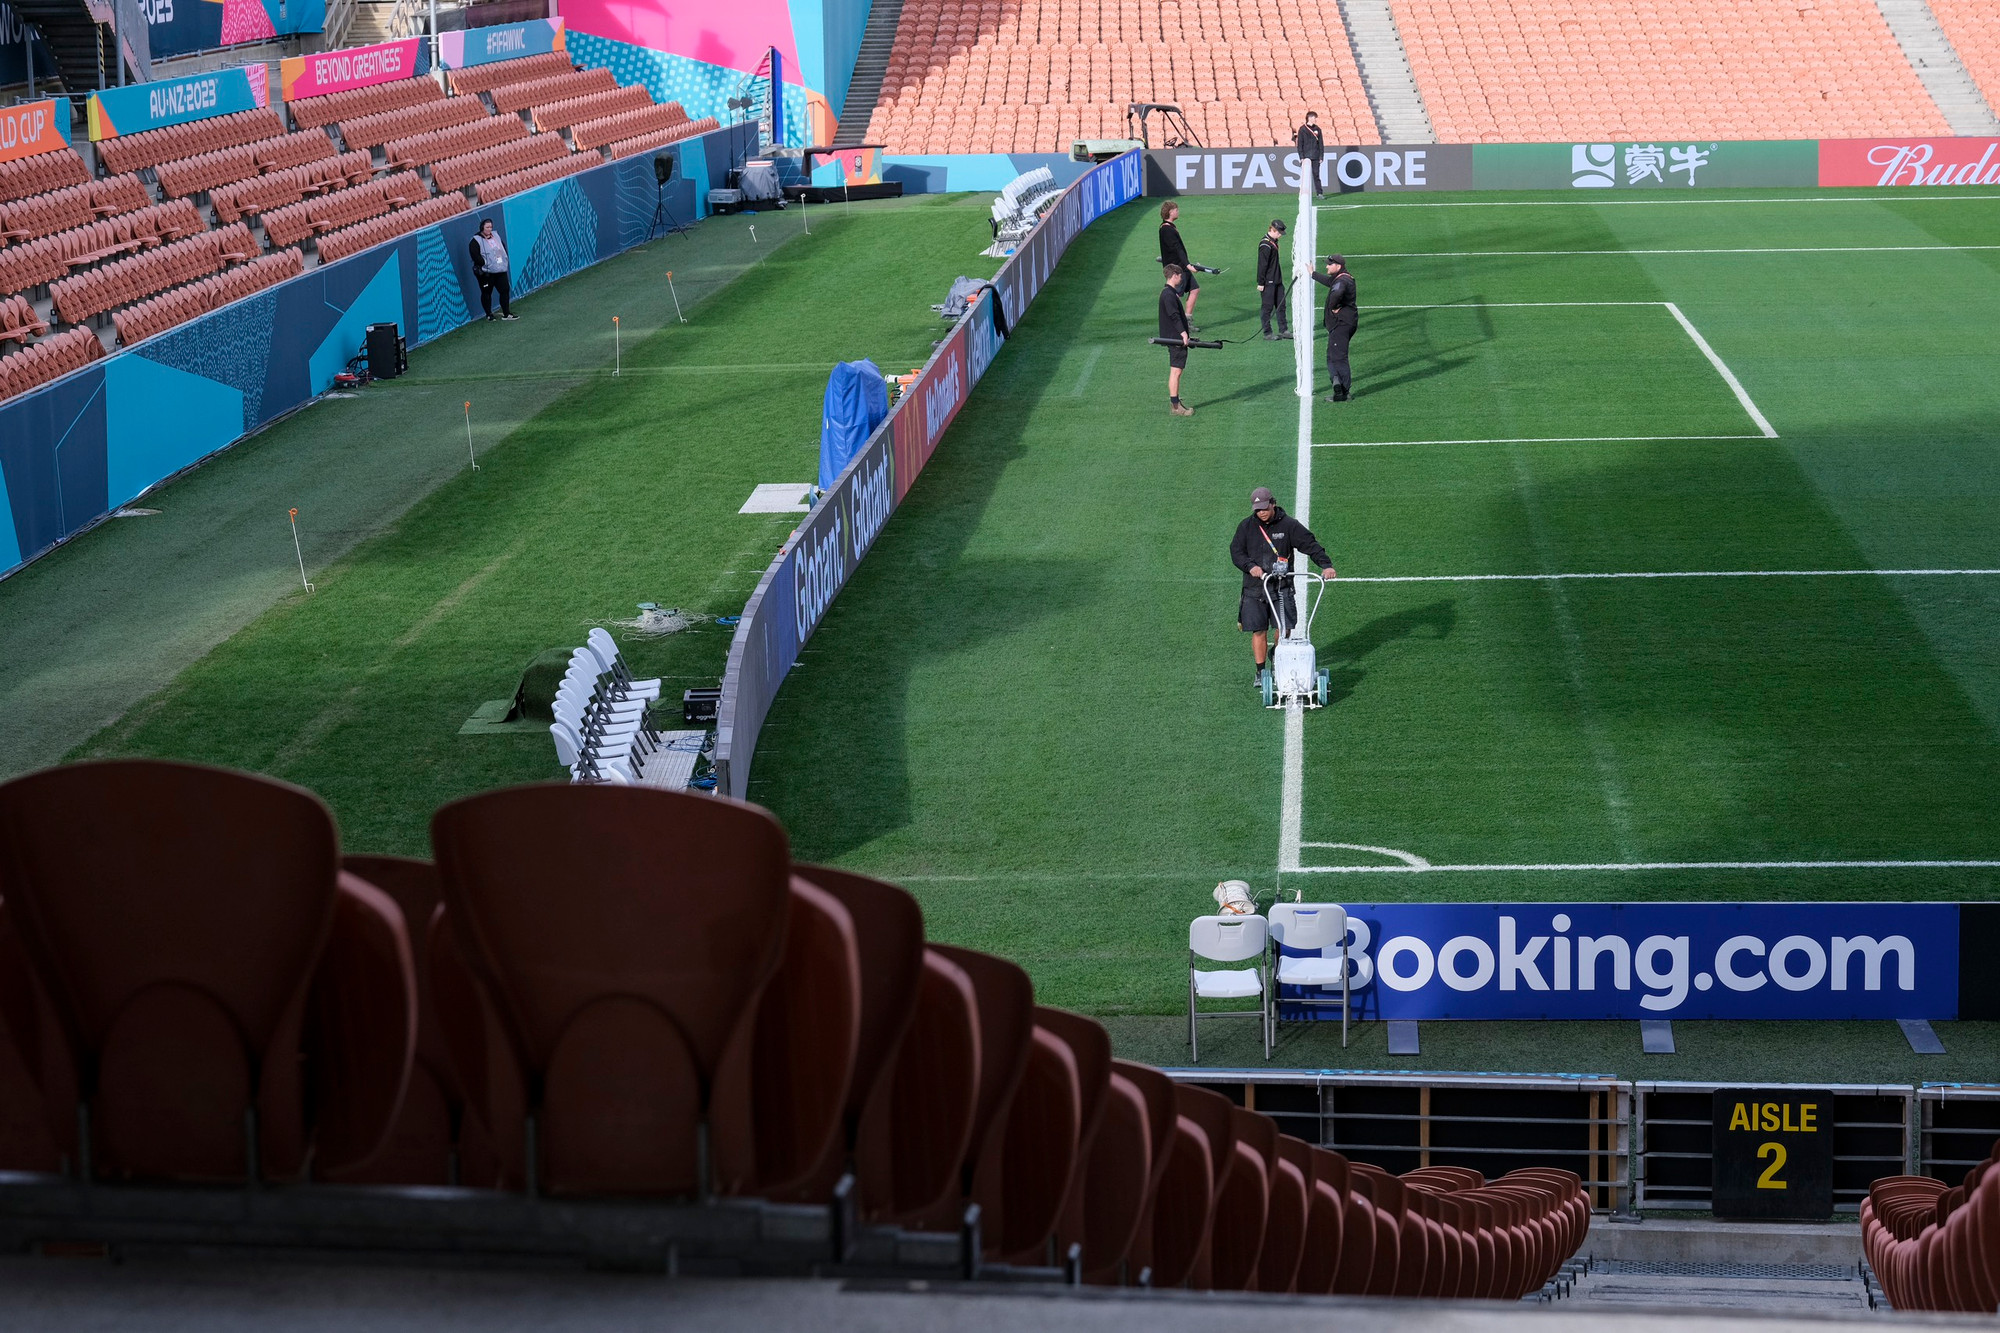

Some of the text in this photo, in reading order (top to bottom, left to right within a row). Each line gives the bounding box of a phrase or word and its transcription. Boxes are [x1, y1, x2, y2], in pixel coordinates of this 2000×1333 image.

[486, 28, 526, 55] #FIFAWWC
[315, 47, 401, 85] BEYOND GREATNESS
[0, 110, 45, 149] LD CUP
[1097, 165, 1115, 212] VISA
[1120, 153, 1139, 200] VISA
[1283, 151, 1426, 188] STORE
[1624, 143, 1710, 187] 蒙牛
[1082, 175, 1094, 225] VISA
[926, 349, 959, 445] McDonald's
[851, 443, 890, 560] Globant
[795, 506, 844, 643] Globant
[1322, 914, 1915, 1010] Booking.com
[1729, 1103, 1817, 1132] AISLE
[1757, 1142, 1787, 1189] 2
